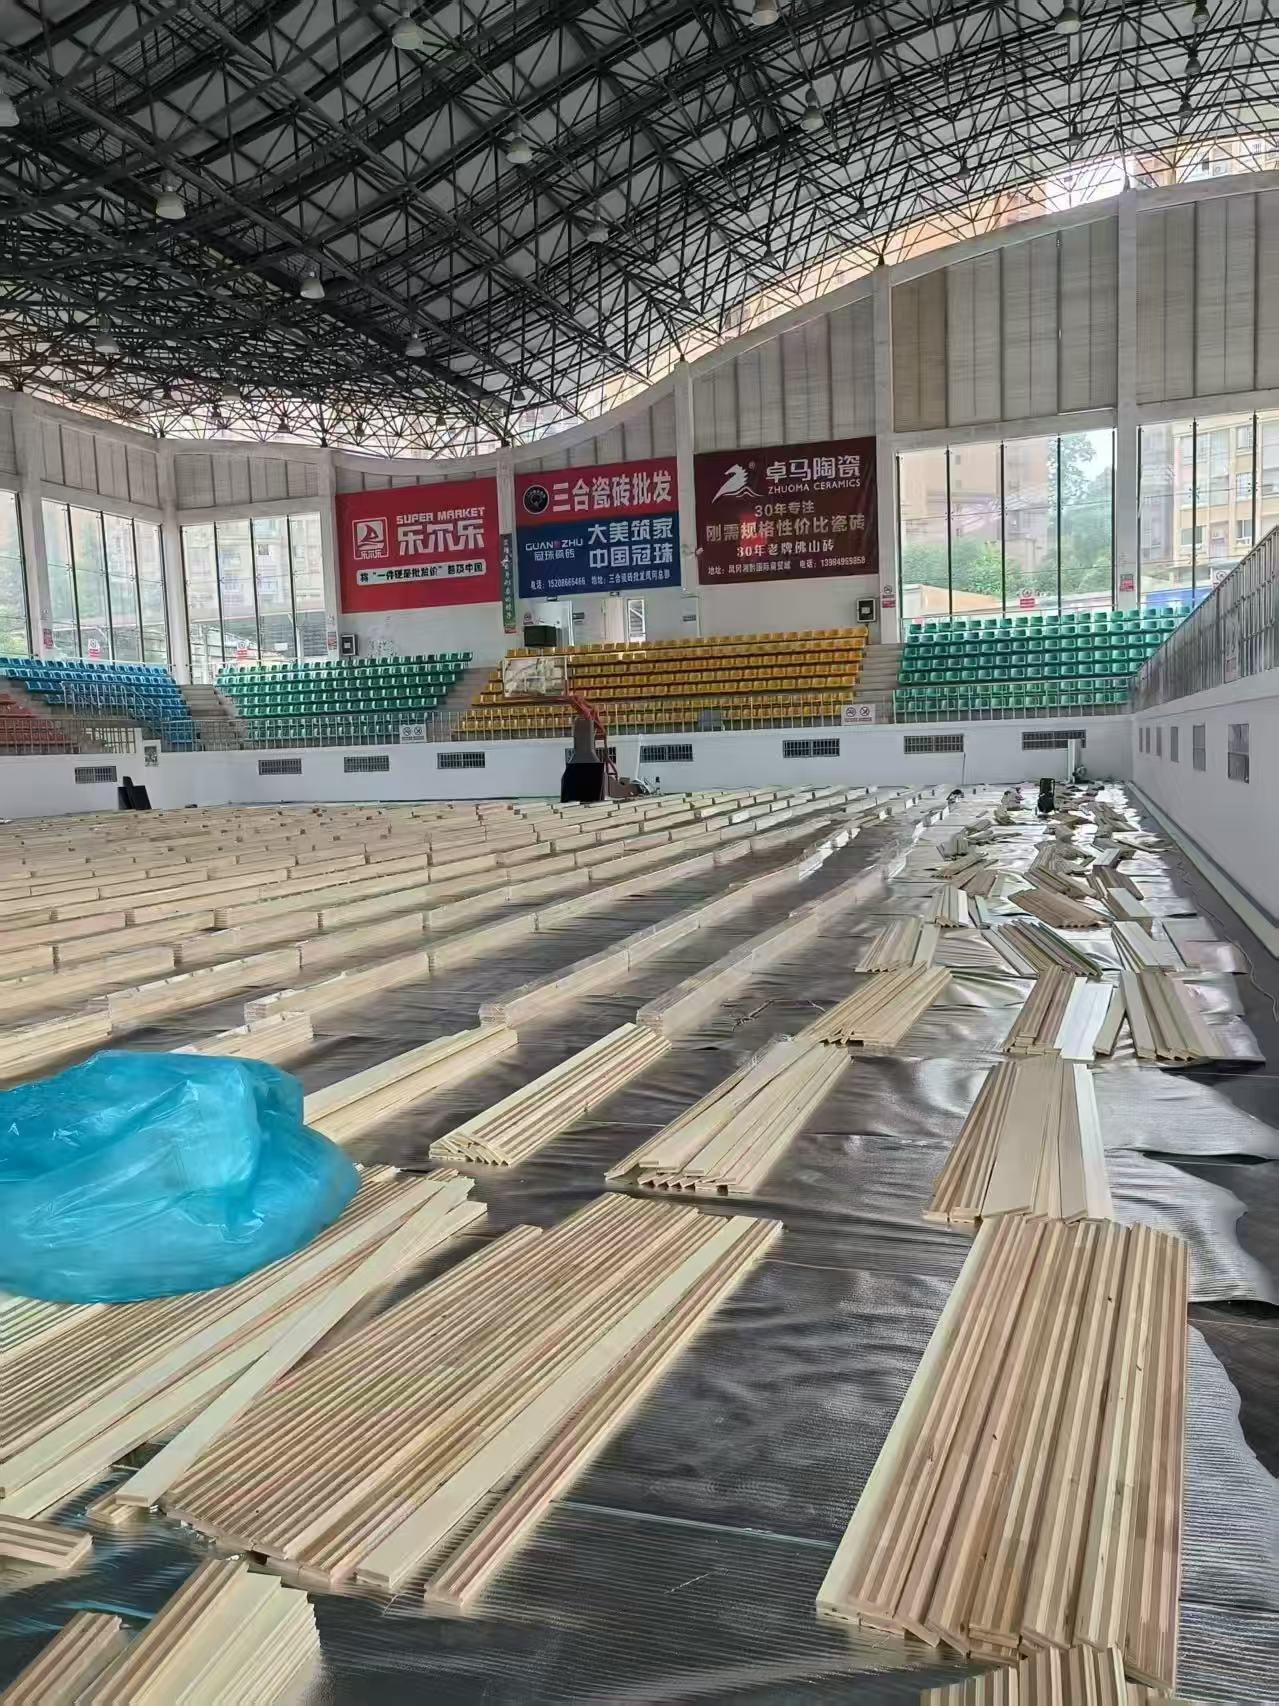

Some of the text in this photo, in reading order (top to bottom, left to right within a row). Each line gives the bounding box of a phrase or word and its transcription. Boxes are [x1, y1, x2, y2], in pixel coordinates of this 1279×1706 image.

[766, 455, 860, 483] 卓马陶瓷
[552, 470, 672, 513] 三合瓷砖批发
[768, 478, 861, 495] ZHUOMA CERAMICS
[396, 507, 486, 525] SUPER MARKET
[754, 501, 815, 518] 30年专注
[397, 519, 485, 556] 乐尔乐
[588, 517, 673, 545] 大美筑家
[705, 514, 865, 542] 刚需规格性价比瓷砖
[589, 543, 673, 569] 中国冠珠
[736, 539, 835, 557] 30年老牌佛山砖
